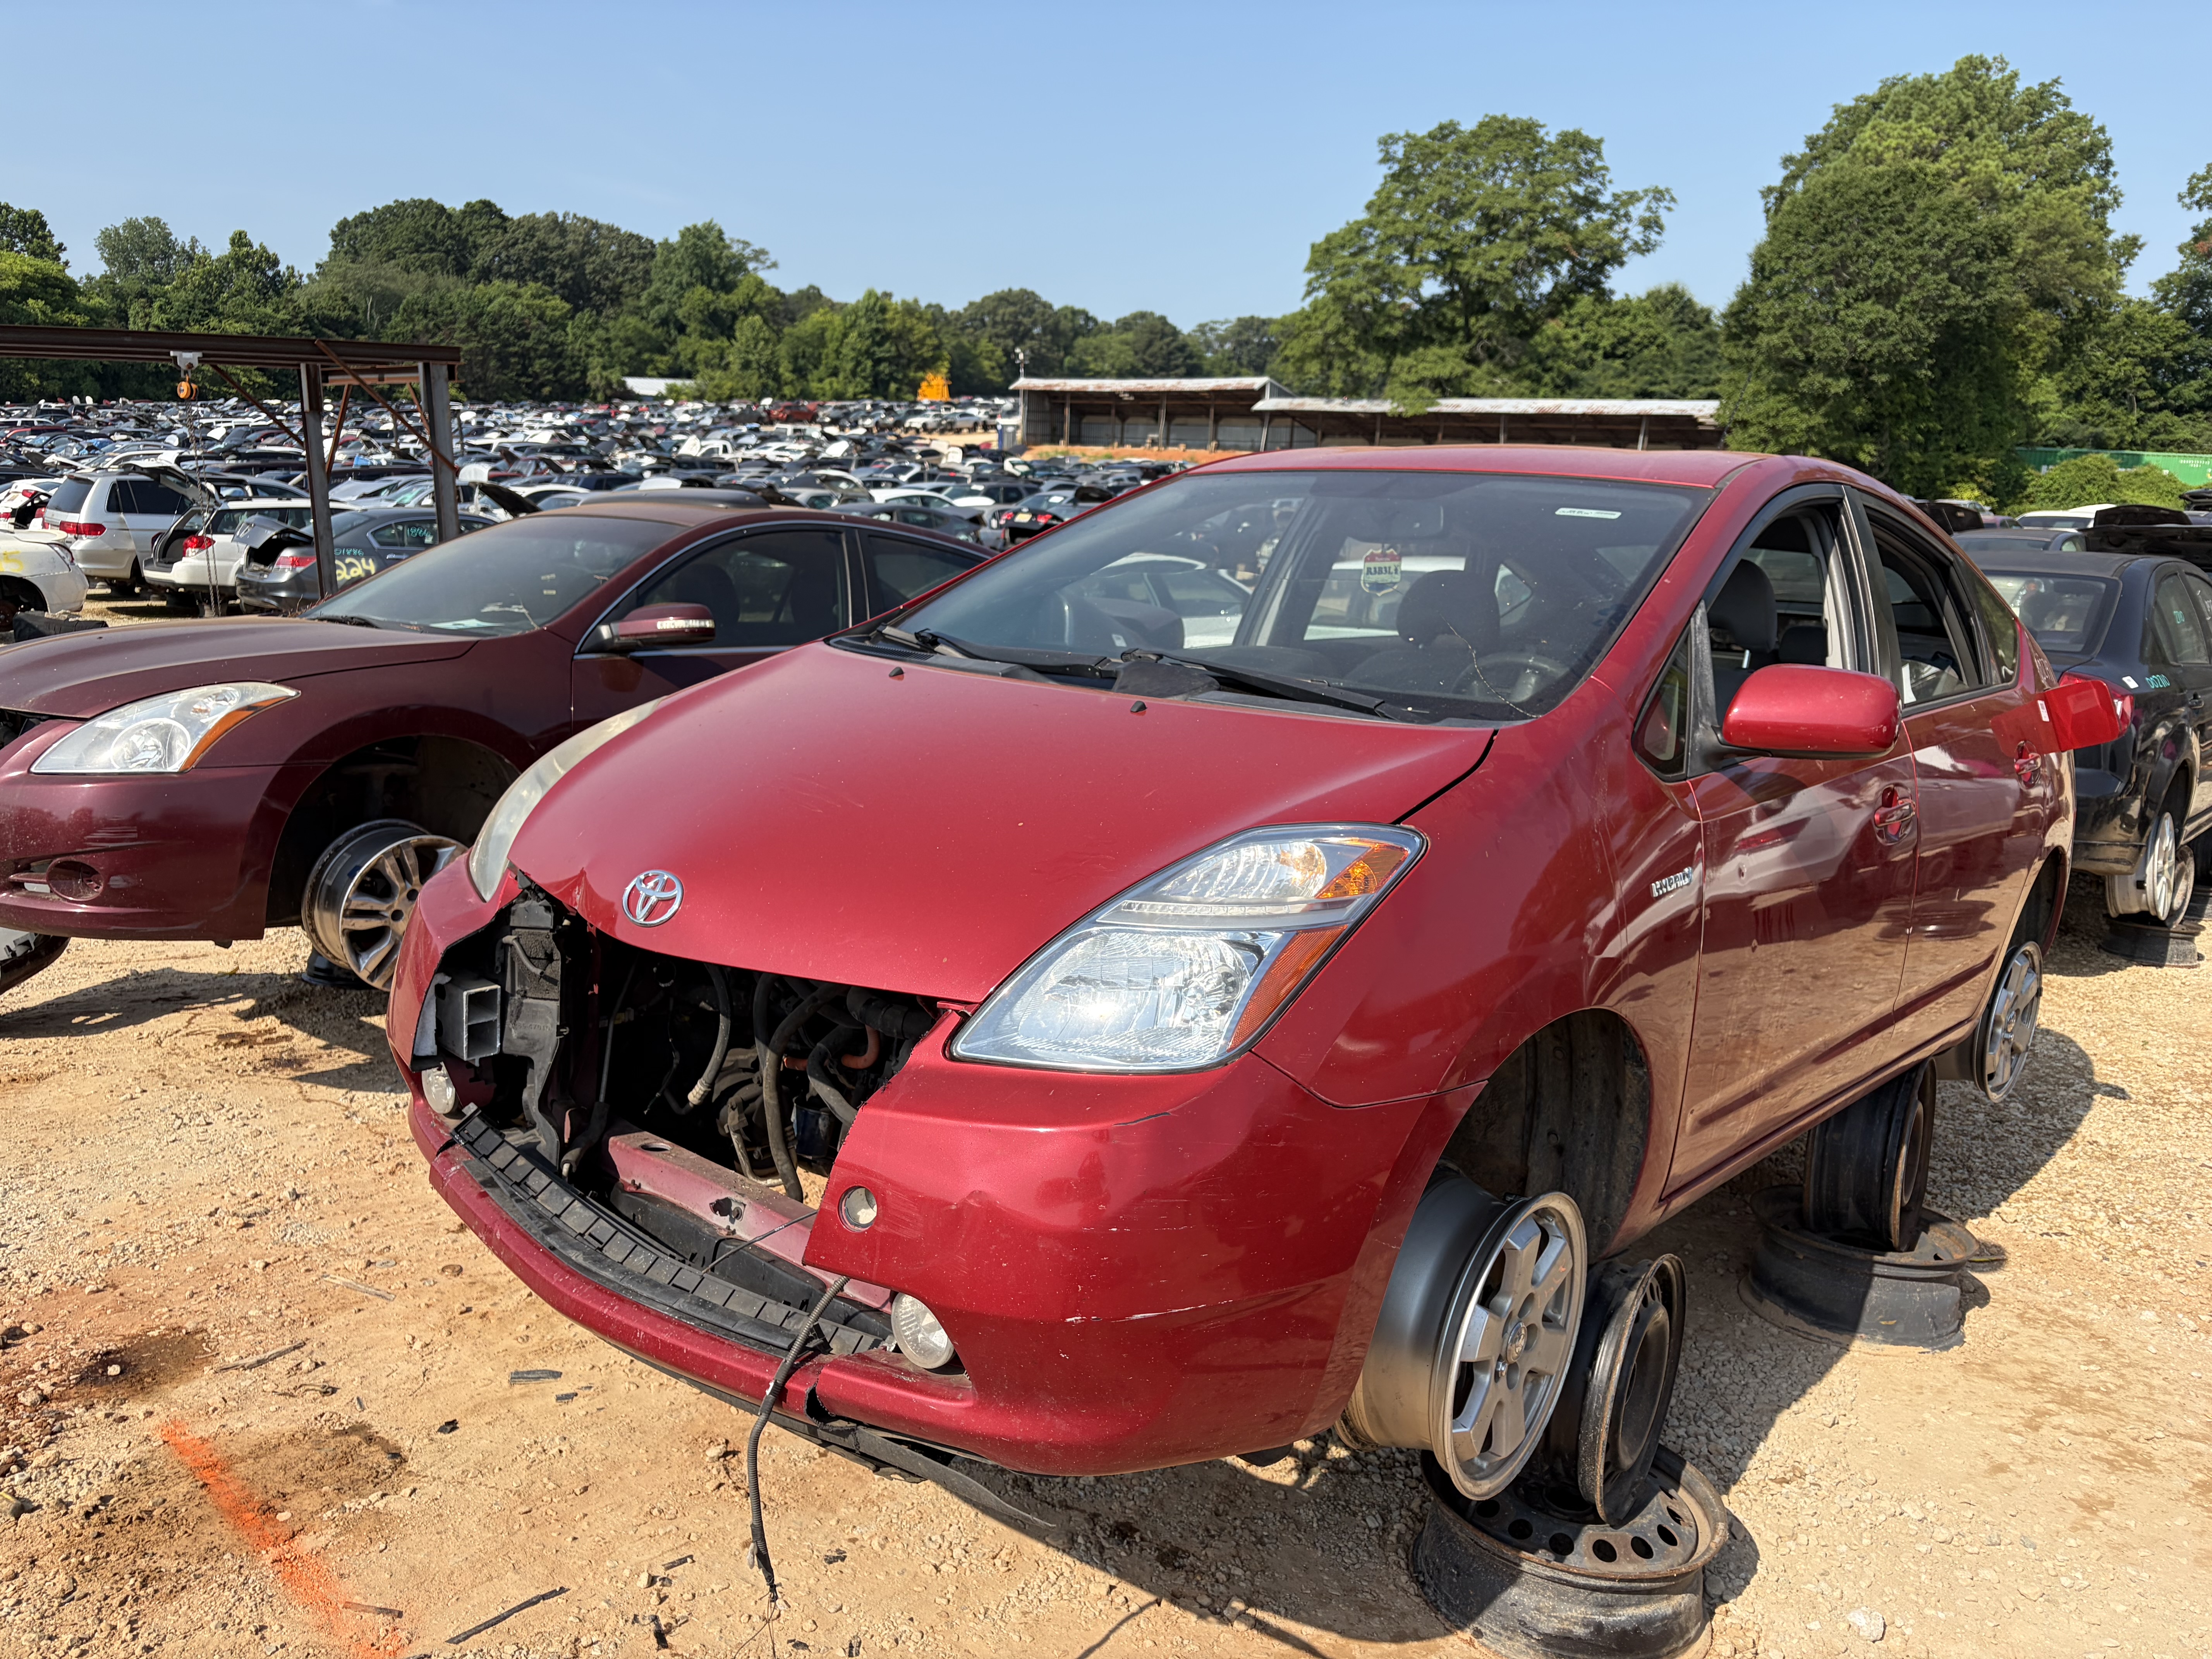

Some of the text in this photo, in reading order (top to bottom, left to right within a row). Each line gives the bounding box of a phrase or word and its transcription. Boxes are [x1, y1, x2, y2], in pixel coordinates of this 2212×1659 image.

[0, 550, 24, 573] 5
[335, 557, 375, 581] 224
[1651, 867, 1692, 897] HYBRID
